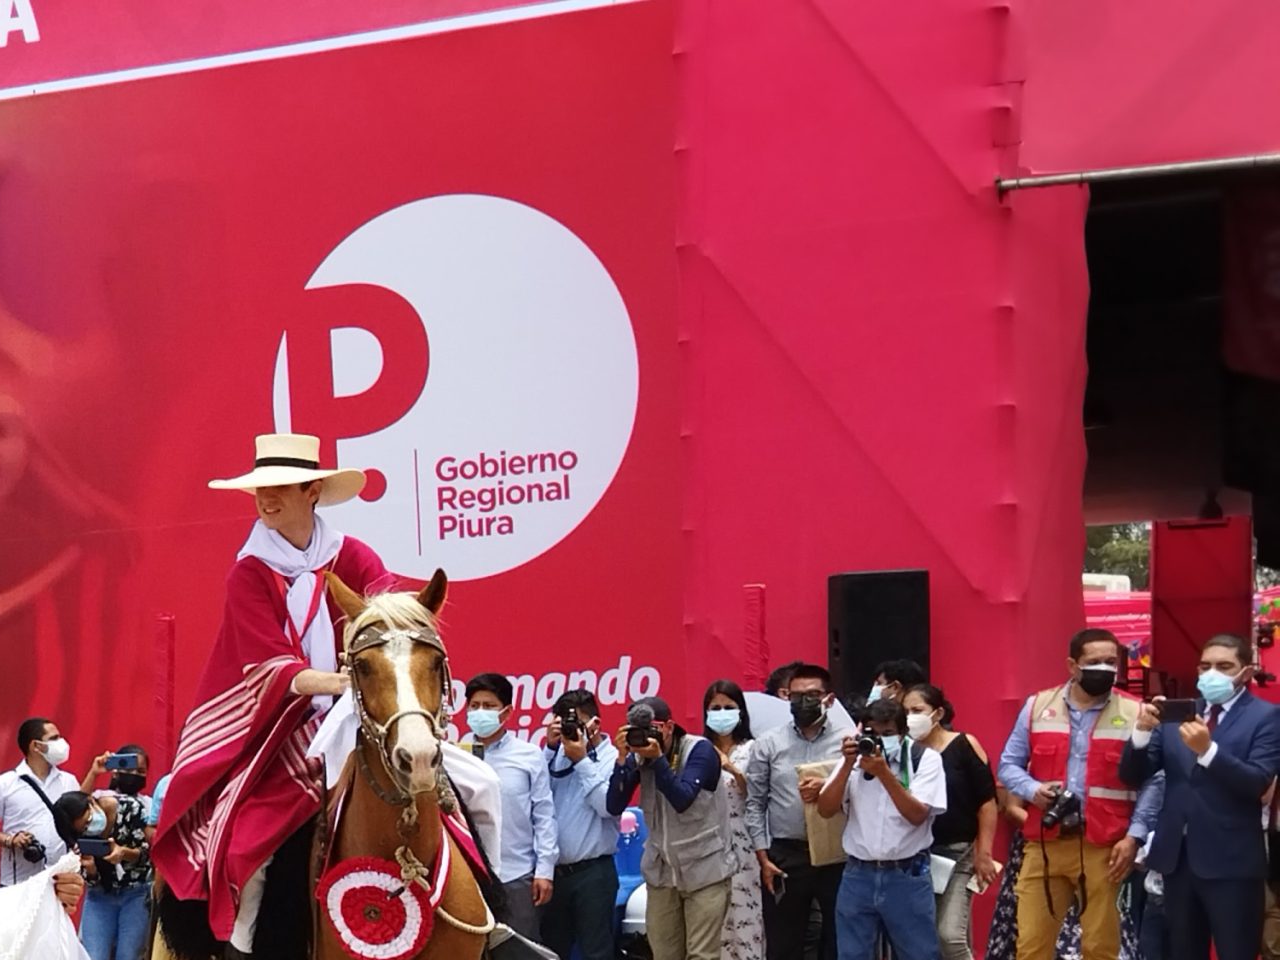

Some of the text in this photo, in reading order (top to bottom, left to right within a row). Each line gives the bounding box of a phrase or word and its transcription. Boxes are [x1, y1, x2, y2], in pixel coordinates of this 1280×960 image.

[435, 450, 578, 482] Gobierno
[437, 474, 570, 512] Regional
[438, 513, 514, 540] Piura
